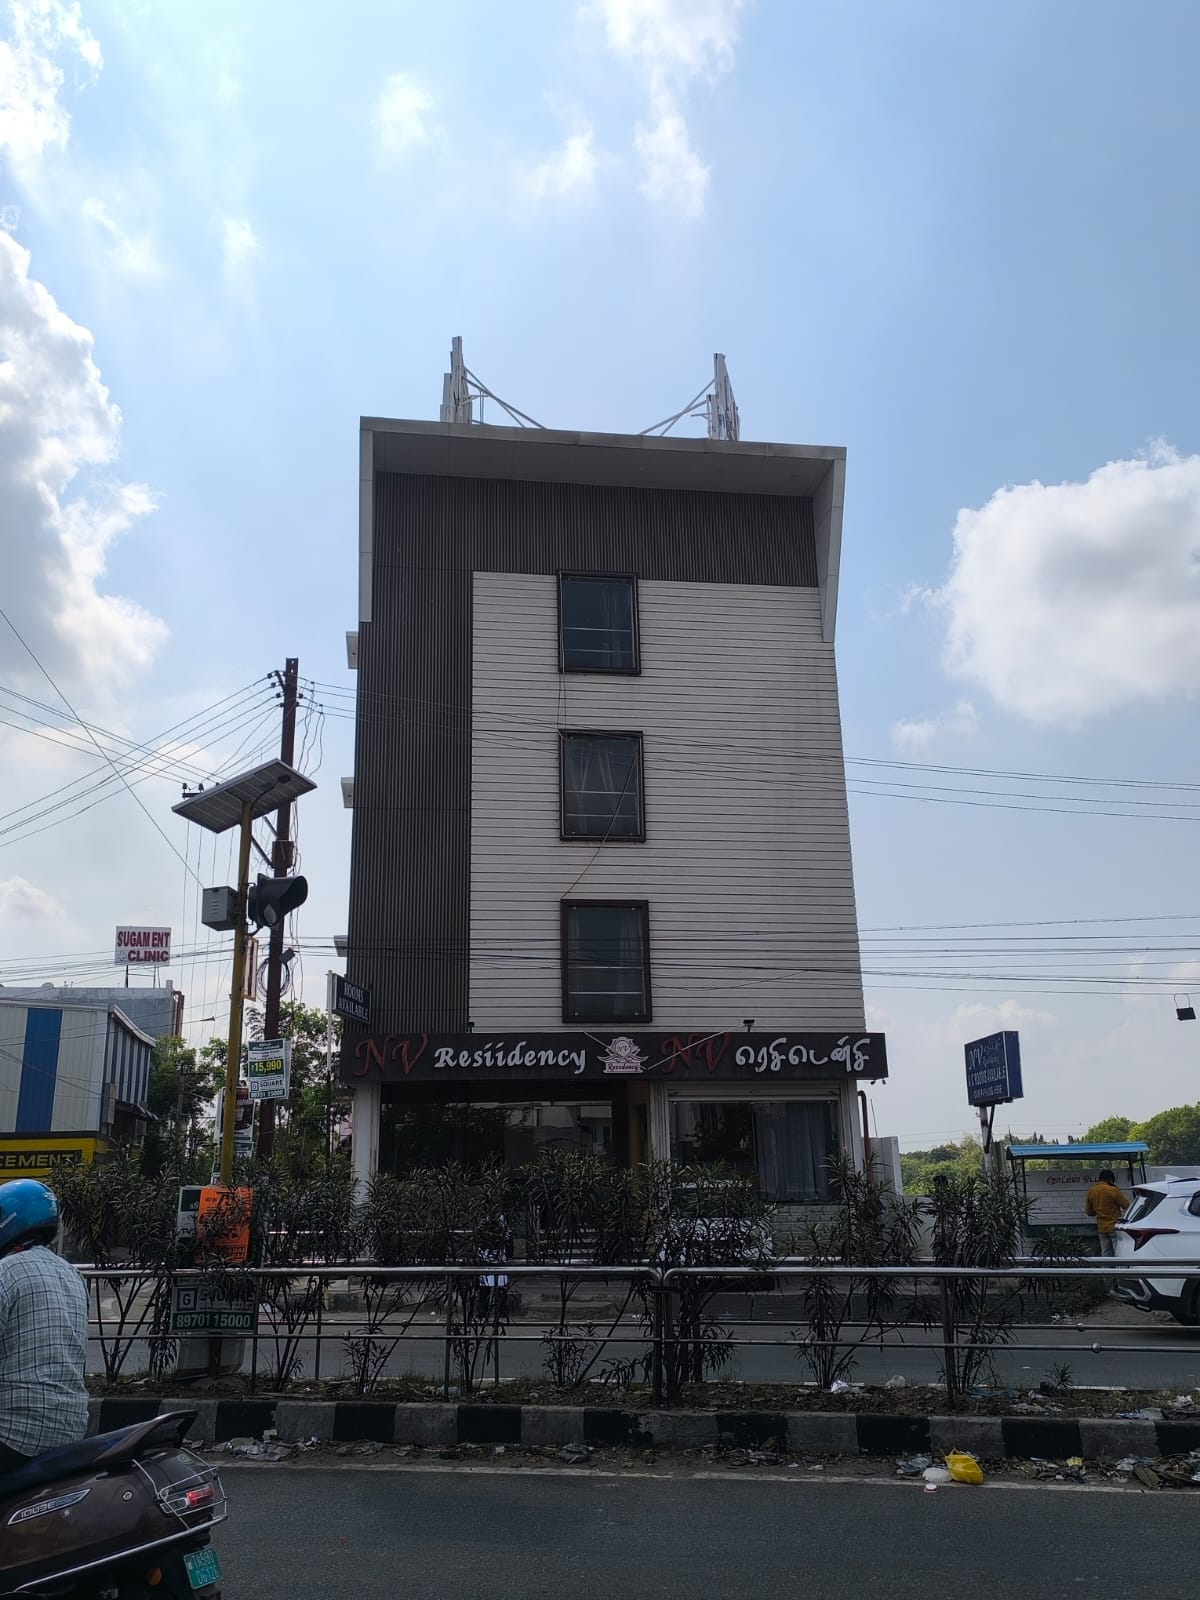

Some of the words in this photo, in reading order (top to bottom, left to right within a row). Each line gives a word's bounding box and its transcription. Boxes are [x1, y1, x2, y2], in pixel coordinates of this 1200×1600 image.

[117, 930, 150, 947] SUGAM
[152, 931, 171, 948] ENT
[127, 950, 169, 962] CLINIC
[354, 1032, 429, 1076] NV
[433, 1041, 587, 1075] Resiidency
[661, 1032, 731, 1073] NV
[735, 1036, 871, 1073] ரெசிடென்சி
[176, 1313, 210, 1328] 89701
[214, 1313, 251, 1328] 15000
